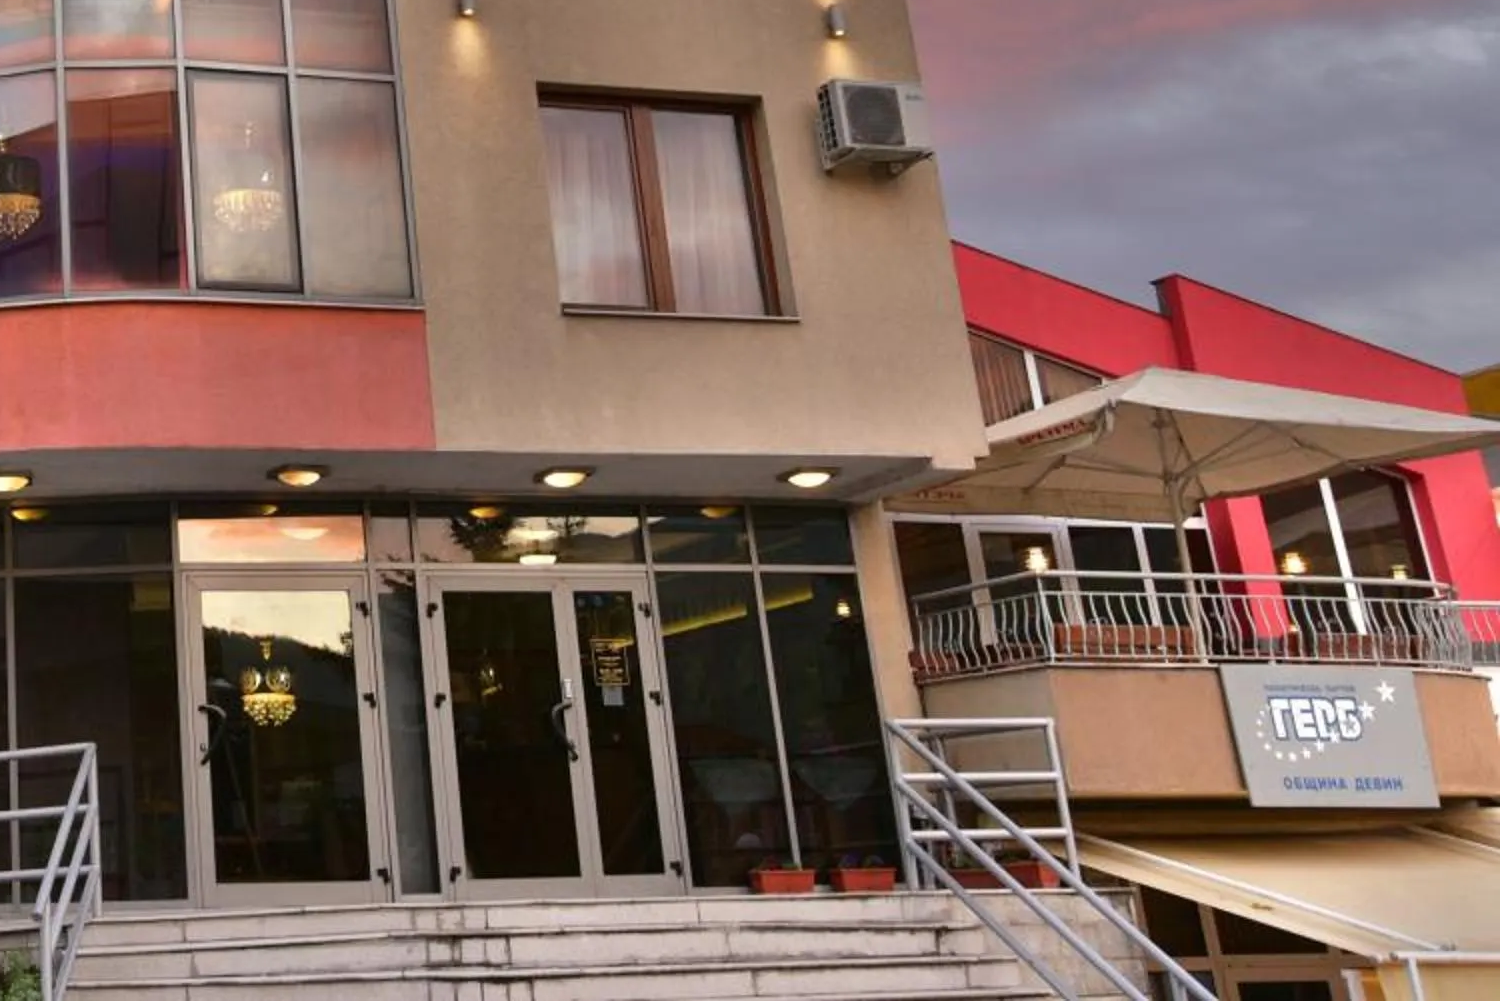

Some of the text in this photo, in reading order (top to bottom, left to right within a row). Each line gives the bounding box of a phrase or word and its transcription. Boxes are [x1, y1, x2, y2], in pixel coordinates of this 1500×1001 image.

[1268, 696, 1363, 741] ГЕРБ
[1283, 775, 1404, 792] ОБЩИНА ДЕВИН
